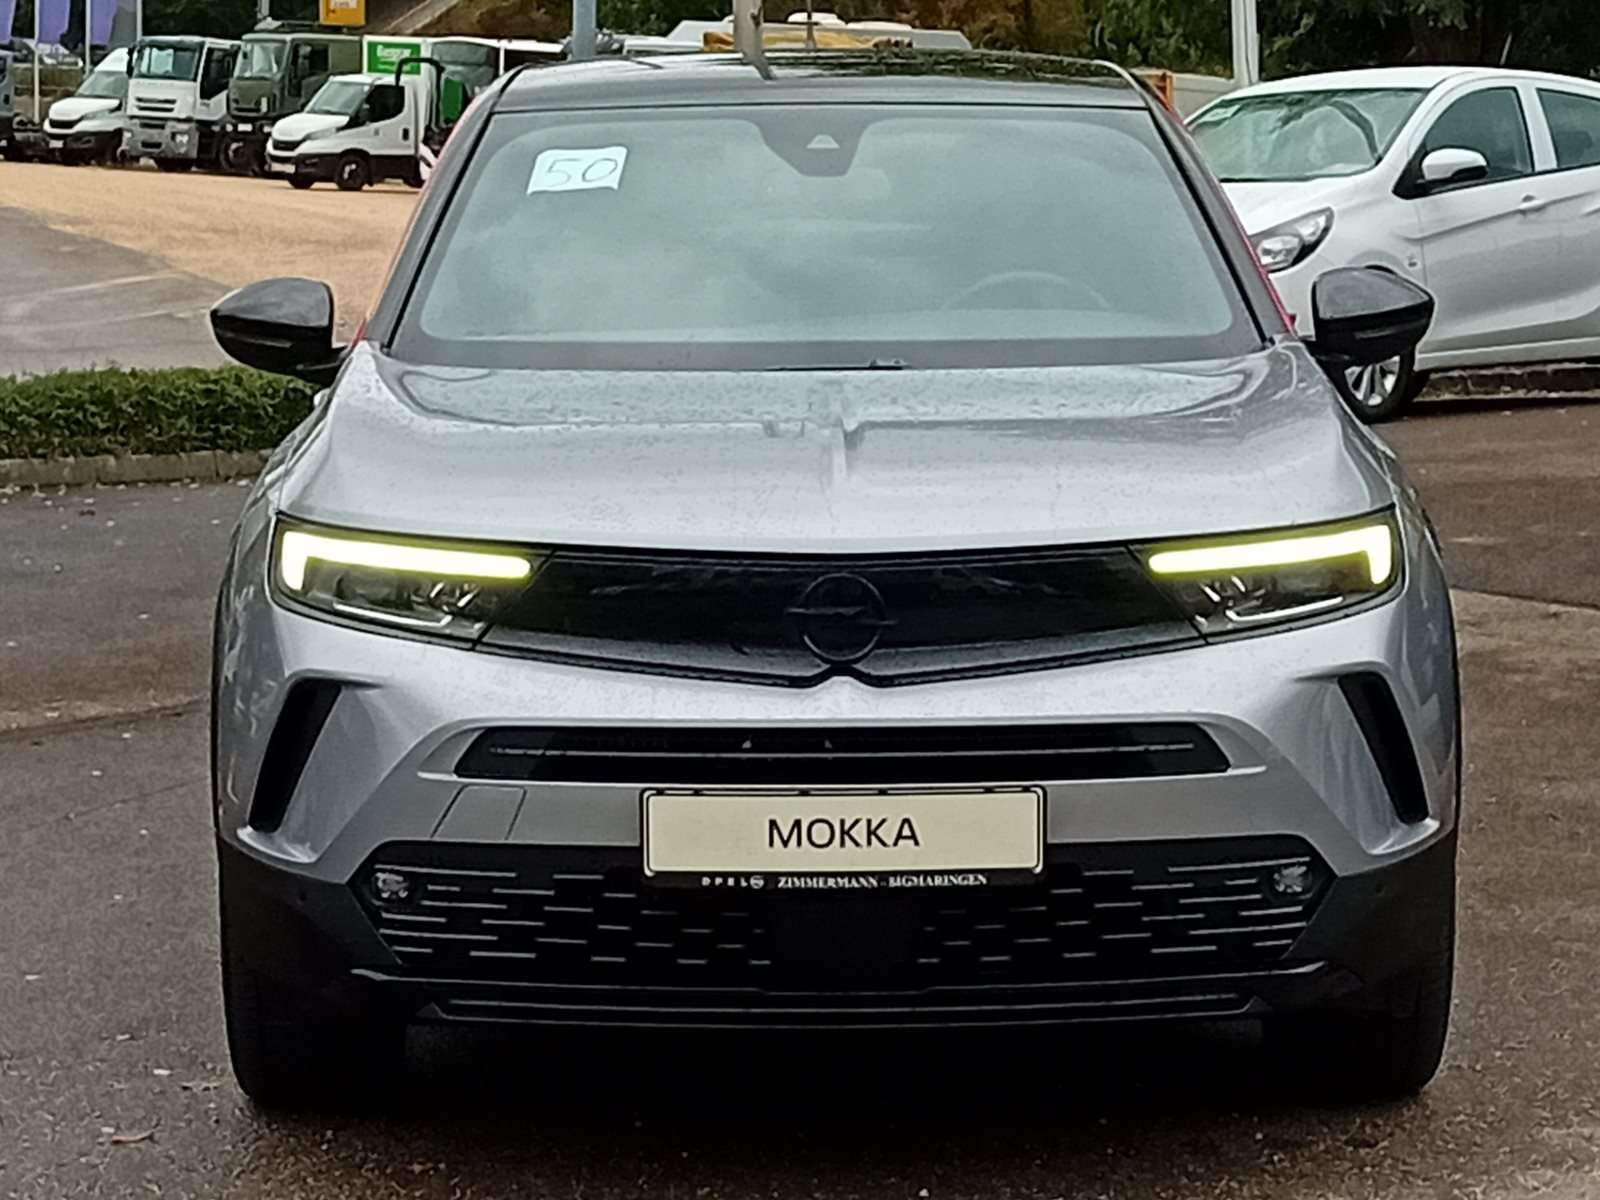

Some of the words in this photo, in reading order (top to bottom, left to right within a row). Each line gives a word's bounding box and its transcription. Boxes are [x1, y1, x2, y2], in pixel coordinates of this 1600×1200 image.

[546, 157, 619, 188] 50
[768, 817, 920, 849] MOKKA
[777, 876, 878, 889] ZIMMERMANN
